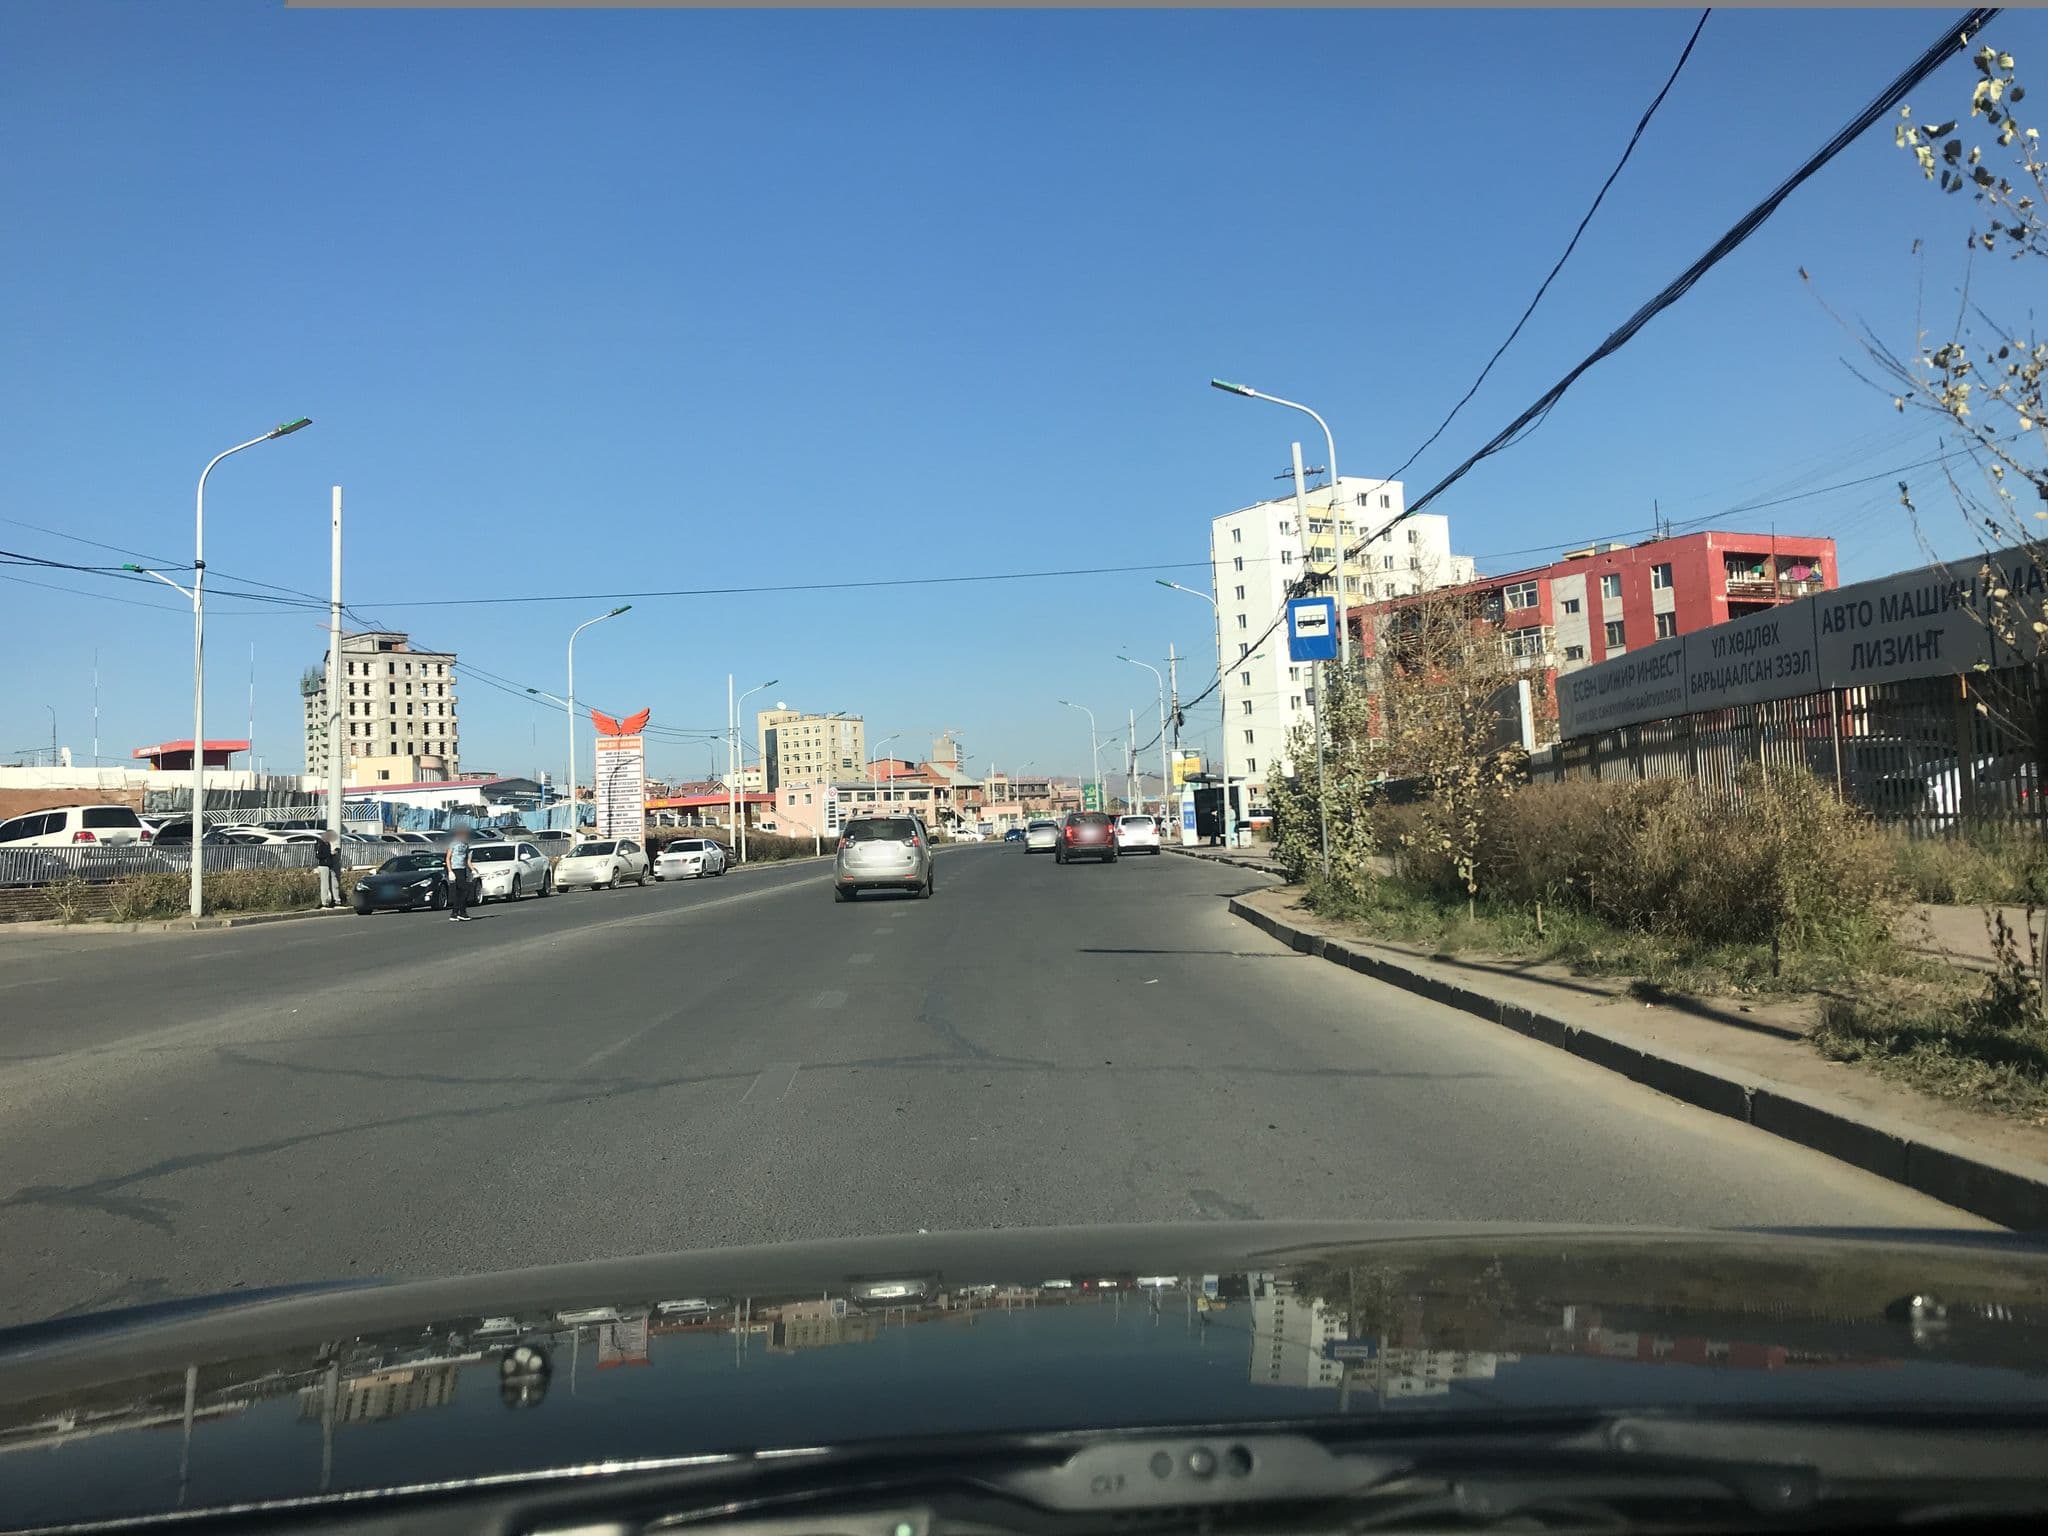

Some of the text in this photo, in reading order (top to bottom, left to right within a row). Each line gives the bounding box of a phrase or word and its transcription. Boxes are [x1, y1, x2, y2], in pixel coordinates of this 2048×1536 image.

[1822, 580, 1976, 634] АВТО МАШИН
[1729, 623, 1780, 656] ХӨДЛӨХ
[1851, 630, 1944, 671] ЛИЗИНГ
[1637, 650, 1681, 683] ИНВЕСТ
[1690, 650, 1810, 694] БАРЬЦААЛСАН ЗЭЭЛ
